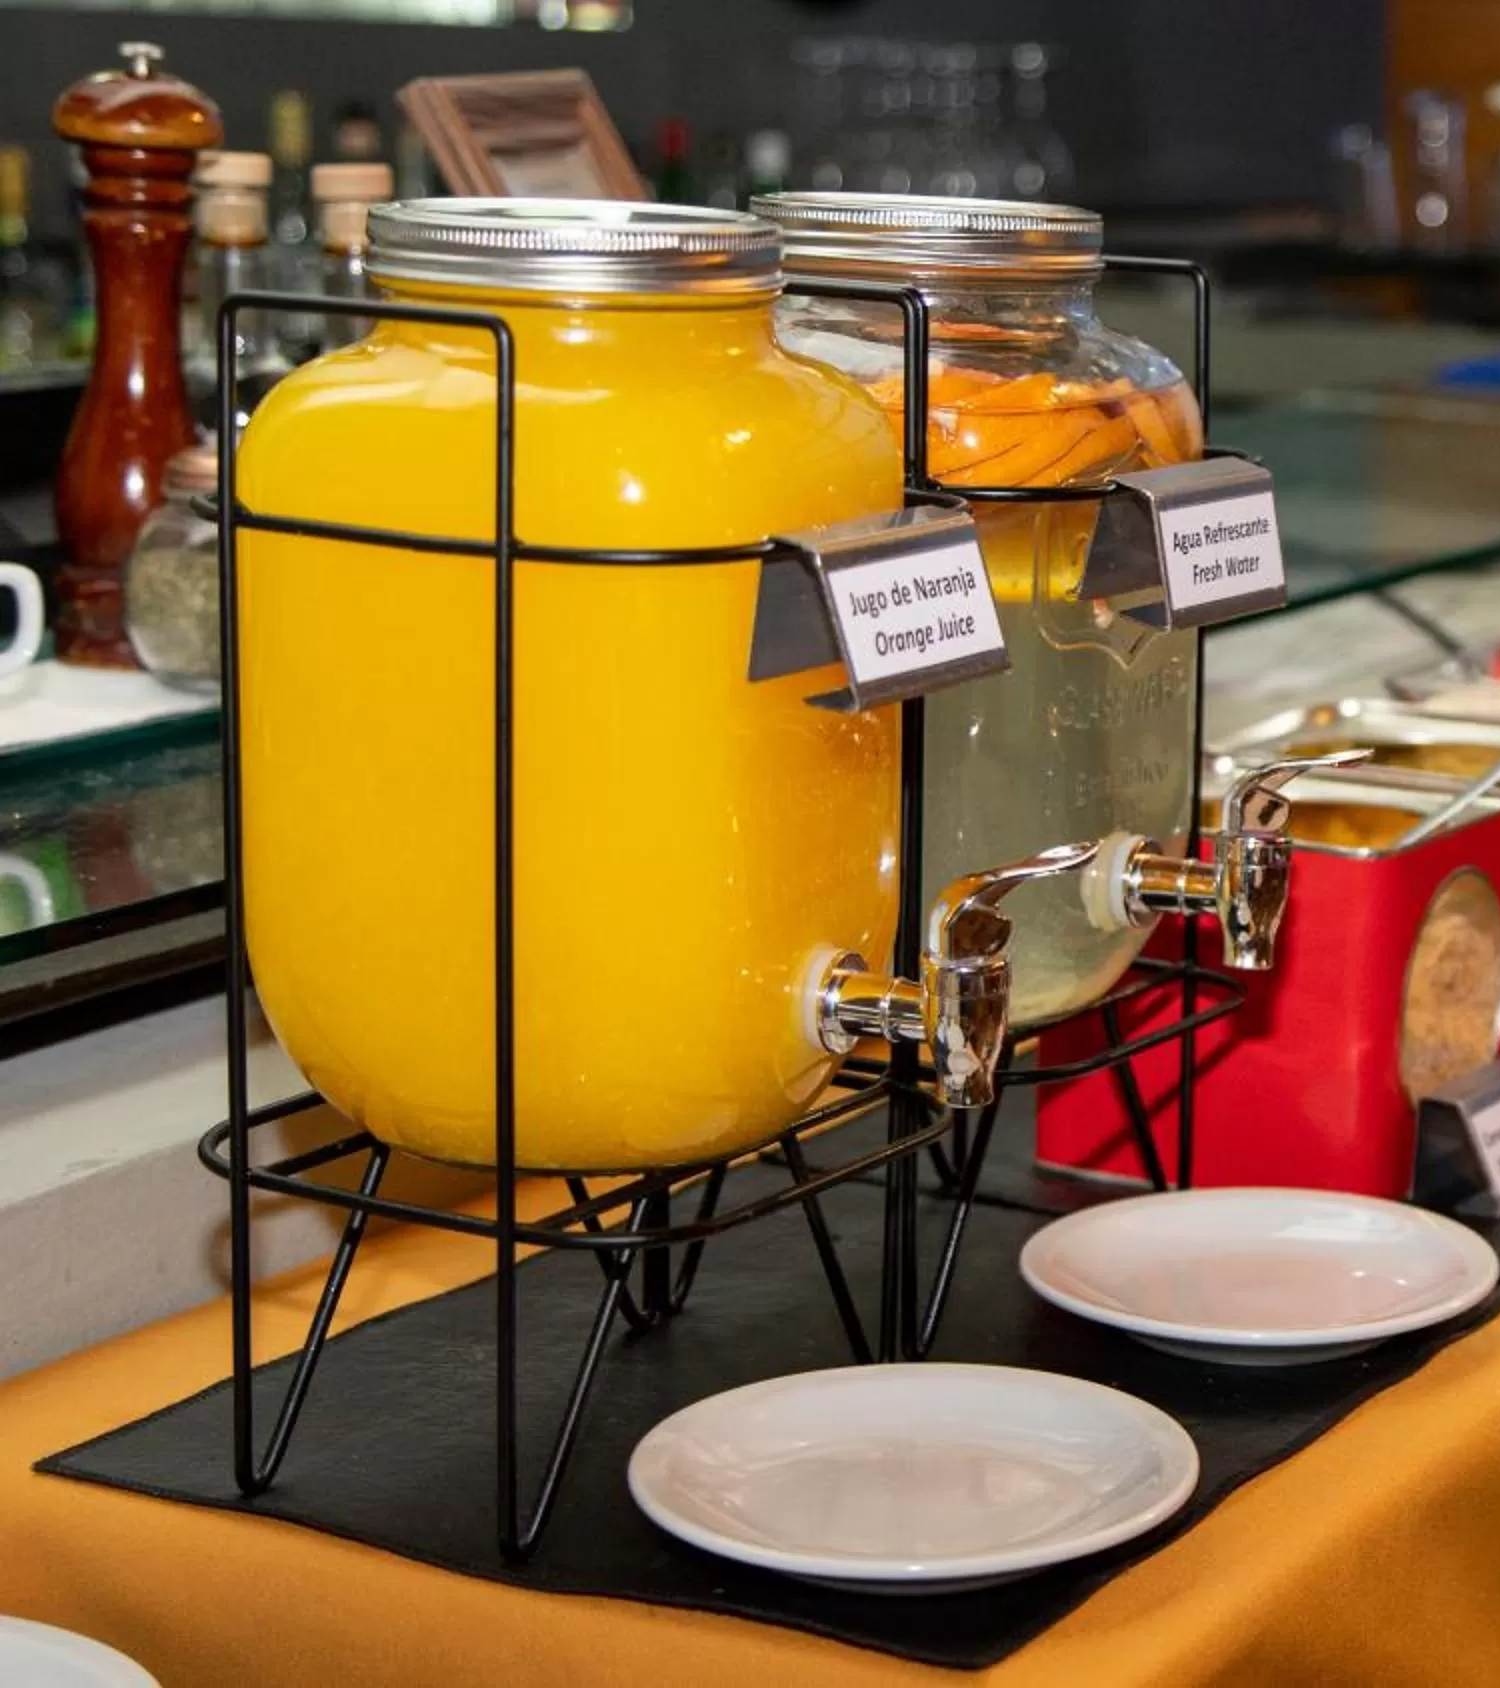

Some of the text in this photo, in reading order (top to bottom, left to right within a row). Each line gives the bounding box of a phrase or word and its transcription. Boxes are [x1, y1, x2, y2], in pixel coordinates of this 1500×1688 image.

[1173, 517, 1270, 555] Agua Refrescante
[1193, 556, 1260, 585] Fresh Water
[849, 568, 976, 618] Jugo de Naranja
[875, 614, 975, 656] Orange Juice
